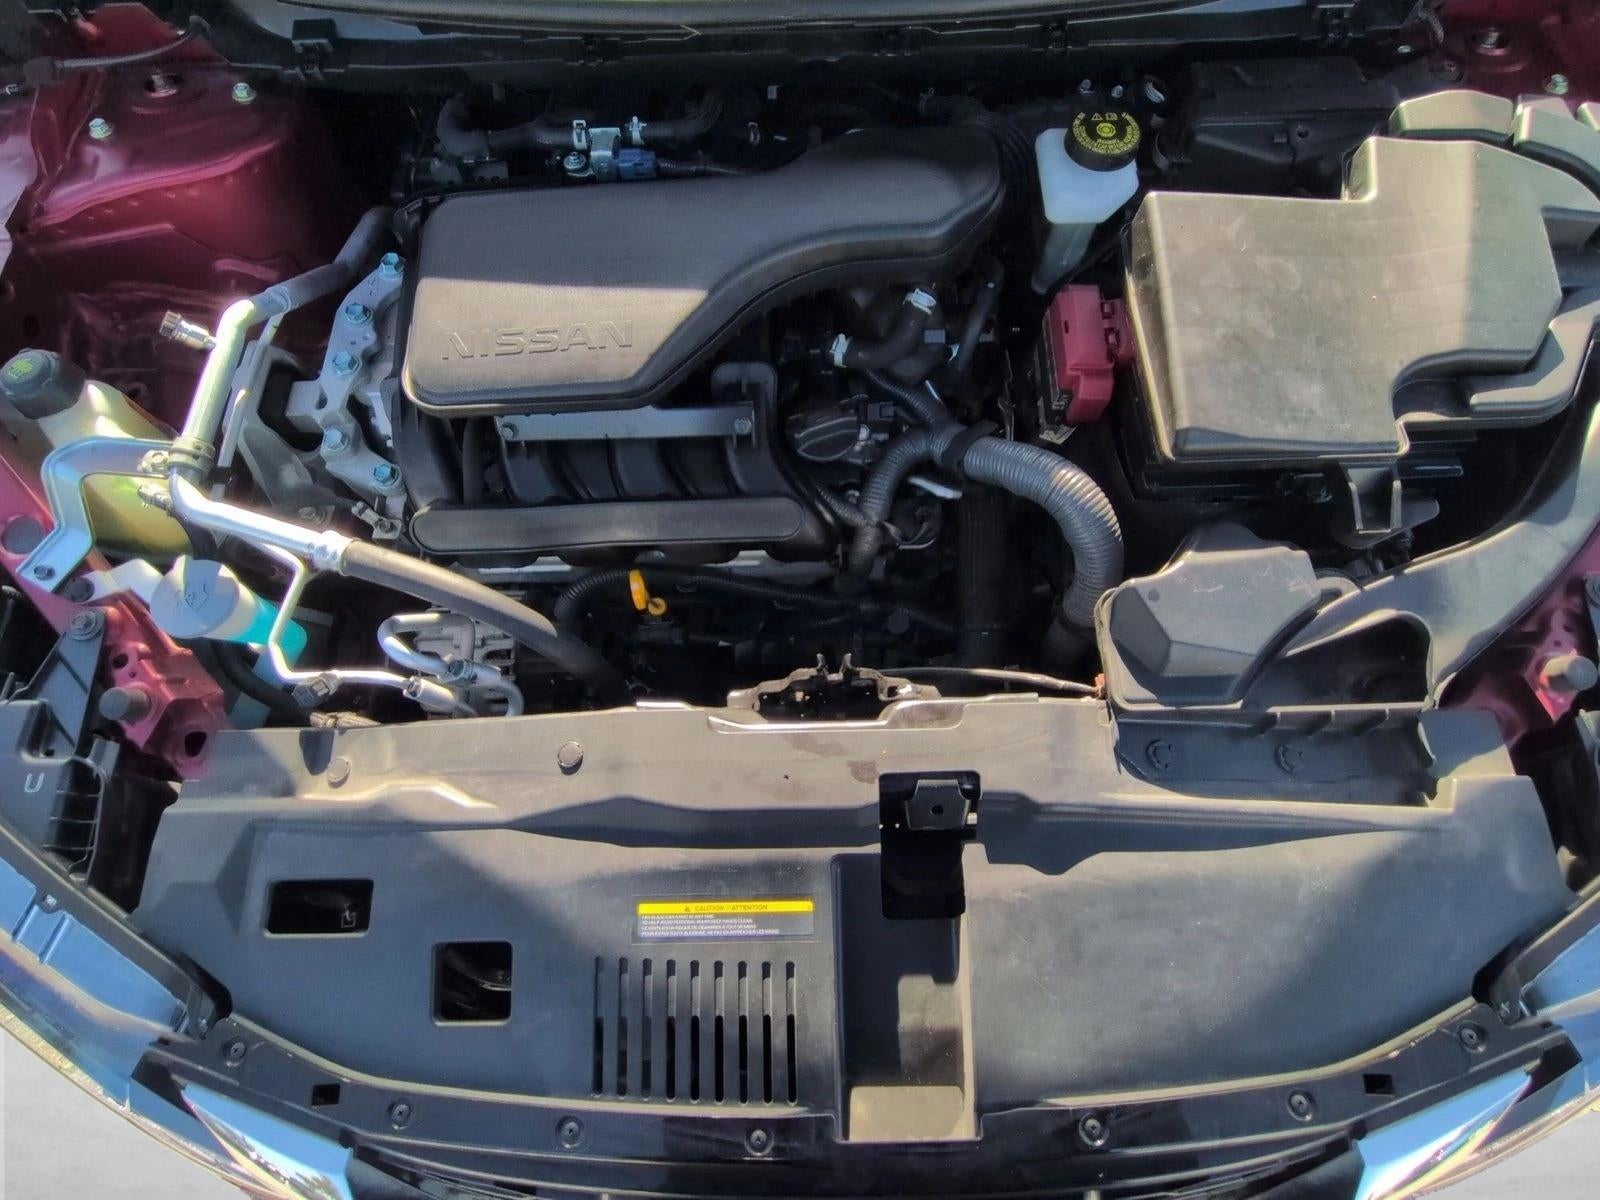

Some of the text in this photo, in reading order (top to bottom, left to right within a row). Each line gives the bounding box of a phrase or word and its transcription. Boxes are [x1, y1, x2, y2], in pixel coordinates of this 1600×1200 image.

[441, 320, 632, 360] NISSAN
[694, 904, 725, 912] CAUTION
[731, 903, 768, 911] ATTENTION
